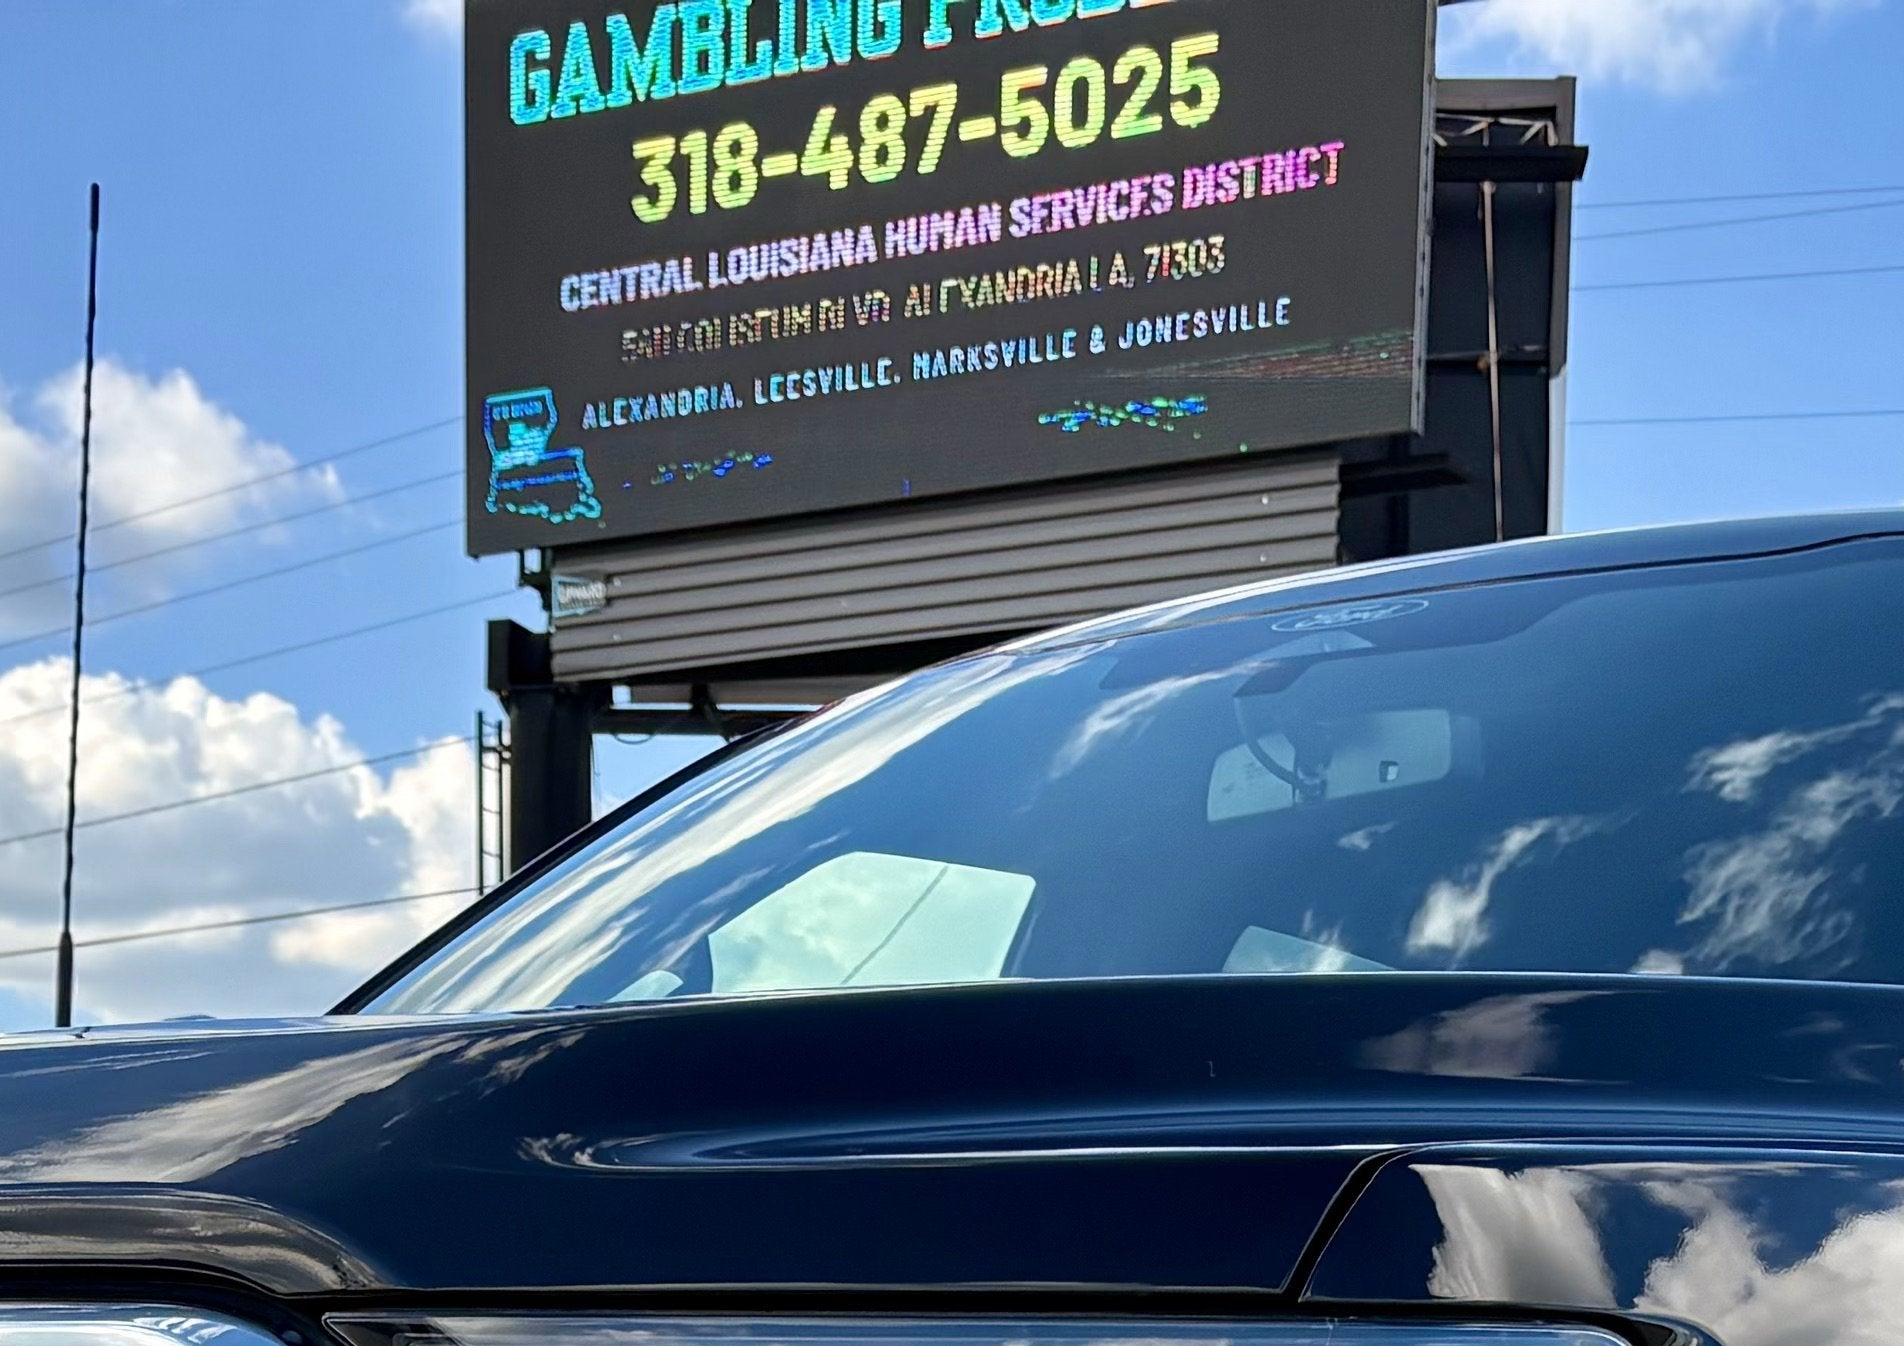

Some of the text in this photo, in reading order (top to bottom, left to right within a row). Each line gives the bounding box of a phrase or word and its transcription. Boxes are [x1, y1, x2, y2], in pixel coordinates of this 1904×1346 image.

[508, 0, 903, 127] GAMBLING
[630, 31, 1222, 224] 318-487-5025
[559, 139, 1345, 313] CENTRAL LOUISIANA HUMAN SERVICES DISTRICT
[1143, 233, 1226, 284] 71303
[912, 328, 1078, 380] MARKSVILLE
[1088, 323, 1107, 355] &
[1117, 296, 1292, 349] JONESVILLE
